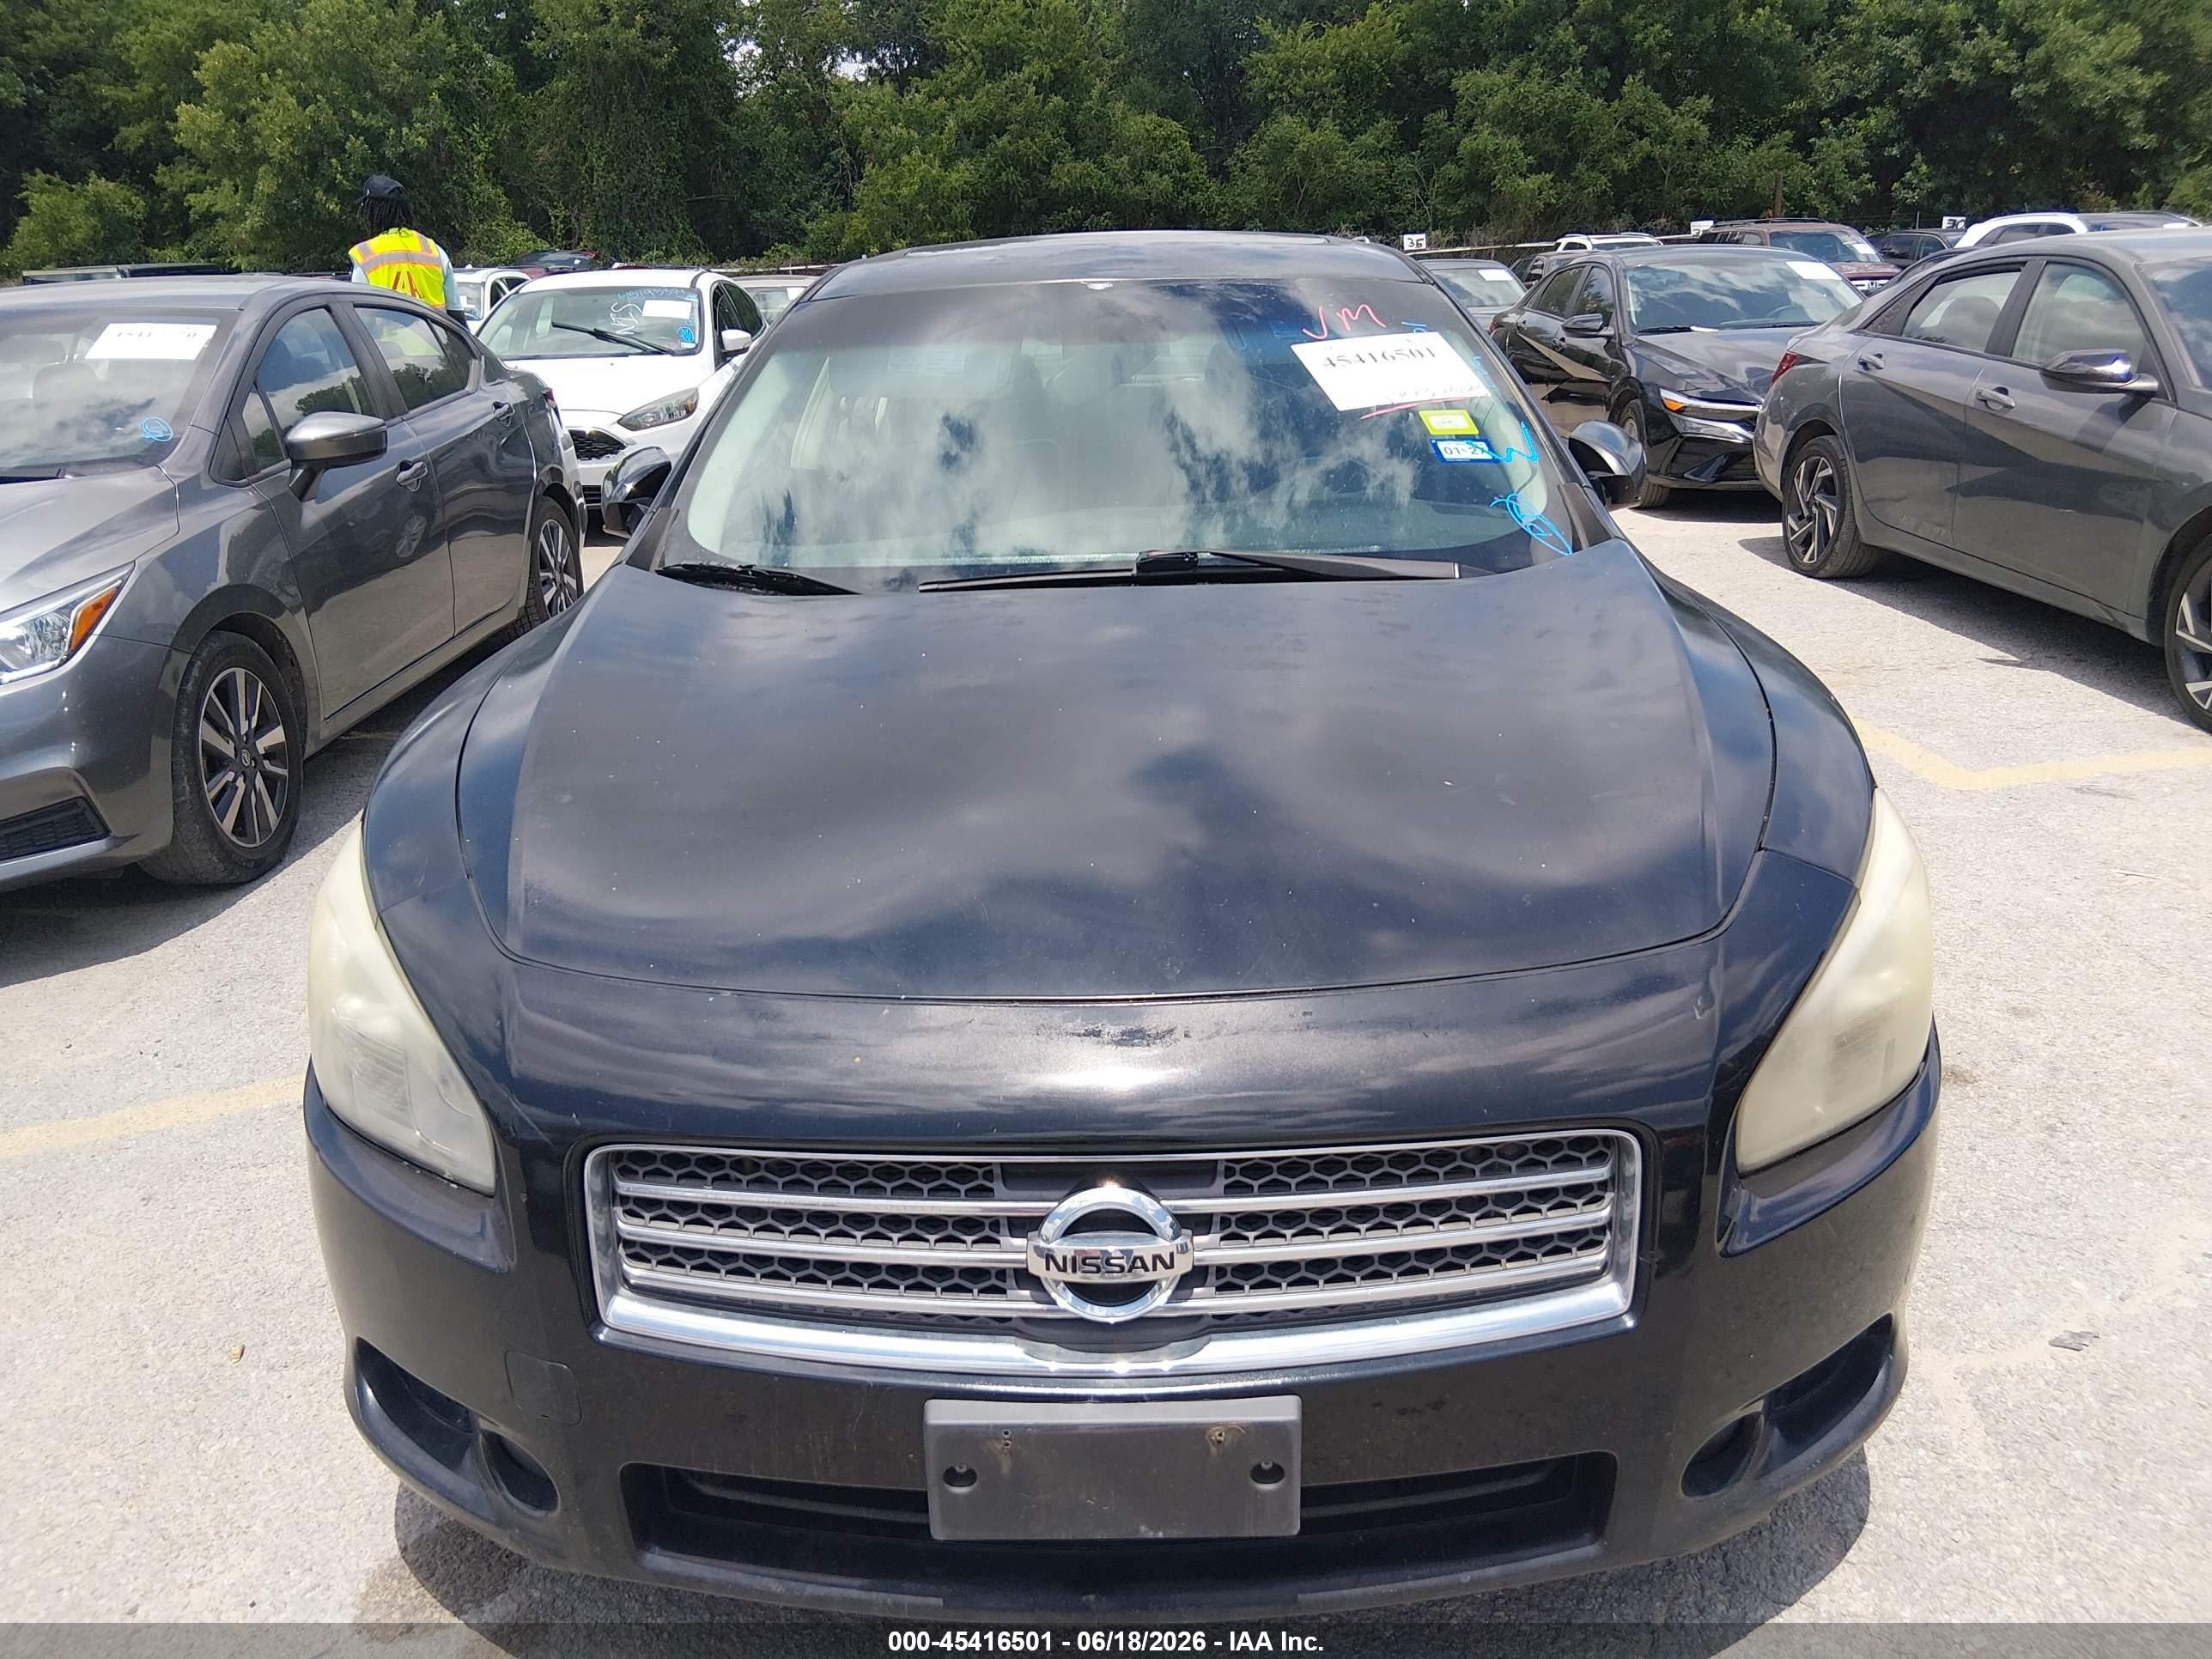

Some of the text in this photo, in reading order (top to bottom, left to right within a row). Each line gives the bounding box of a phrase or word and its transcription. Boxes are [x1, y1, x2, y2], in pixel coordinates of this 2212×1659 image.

[1407, 237, 1425, 247] 35
[1302, 304, 1387, 339] JM
[1323, 347, 1436, 368] 45416501
[1044, 1251, 1176, 1273] NISSAN
